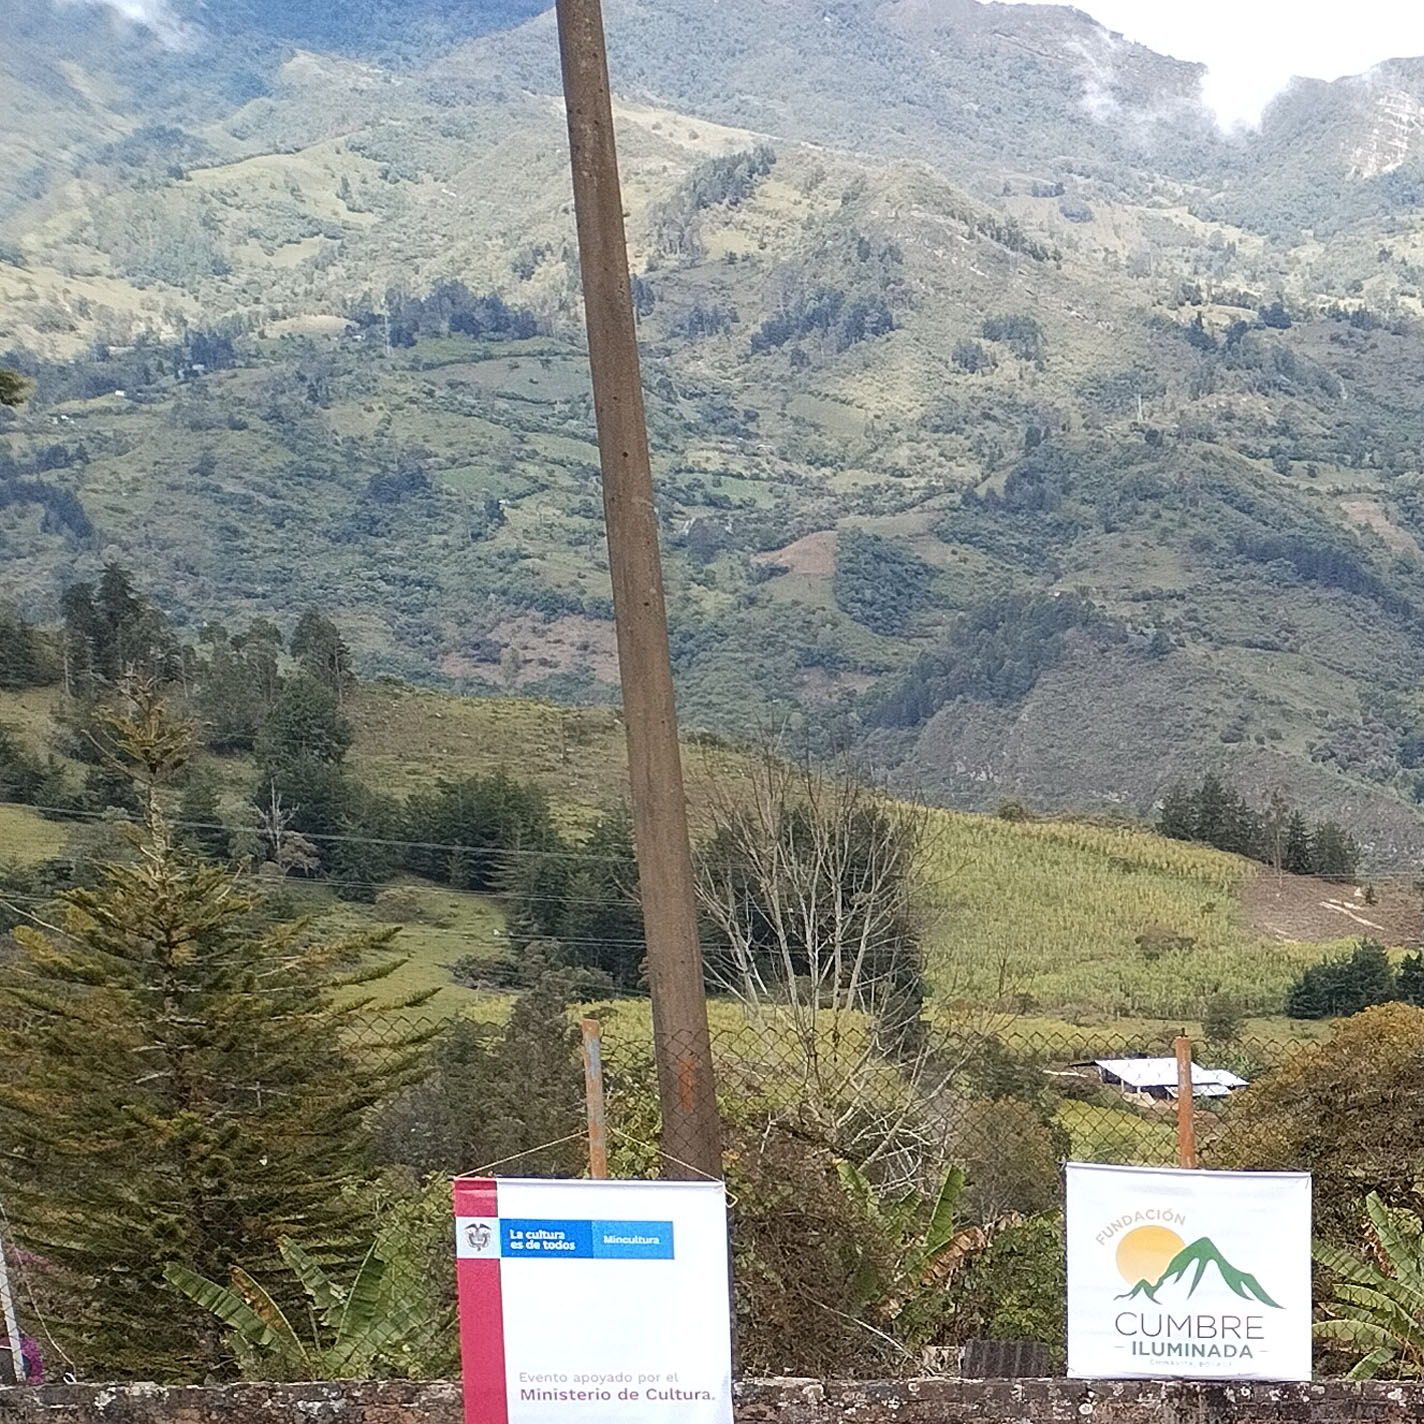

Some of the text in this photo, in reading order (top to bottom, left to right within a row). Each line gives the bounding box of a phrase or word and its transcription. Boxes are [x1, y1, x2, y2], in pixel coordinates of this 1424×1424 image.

[1095, 1208, 1187, 1246] FUNDACIÓN
[509, 1229, 565, 1240] La cultura
[603, 1234, 660, 1245] Mincultura
[510, 1240, 576, 1251] es de todos
[1115, 1312, 1265, 1340] CUMBRE
[1132, 1341, 1254, 1359] ILUMINADA
[519, 1372, 679, 1385] Evento apoyado por el
[520, 1387, 716, 1401] Ministerio de Cultura.
